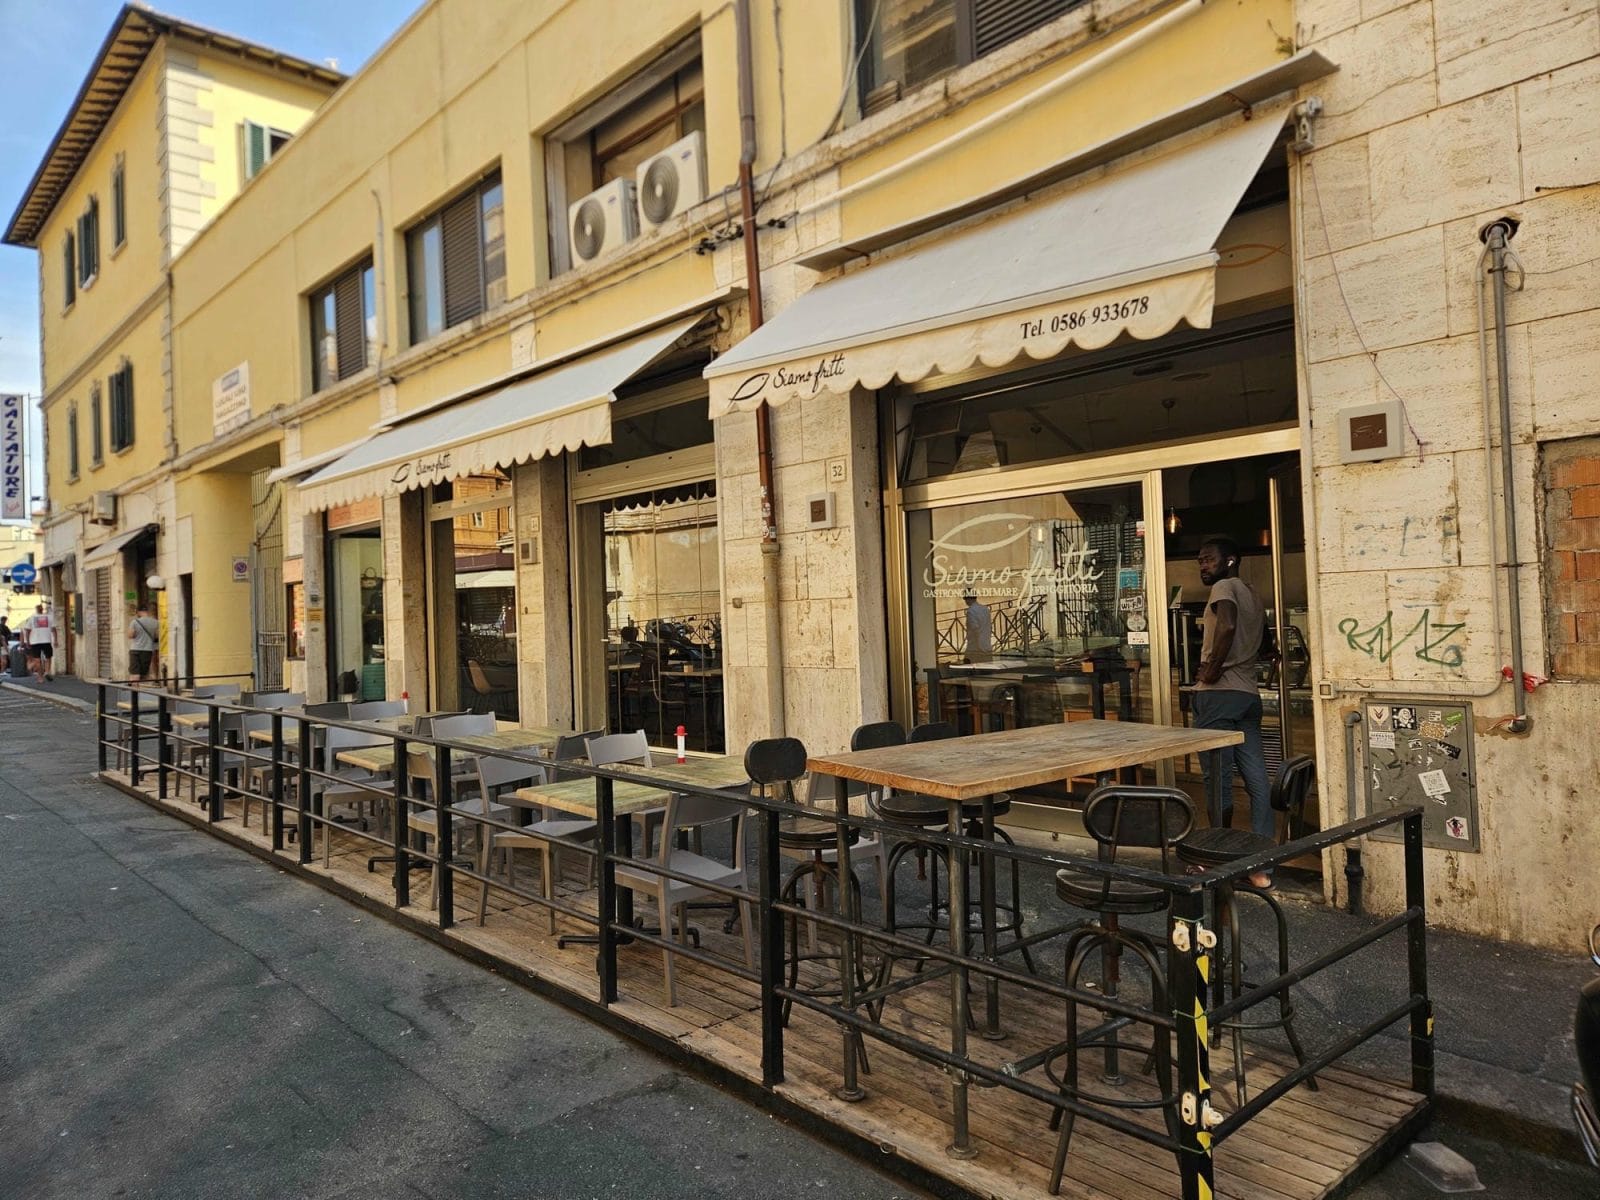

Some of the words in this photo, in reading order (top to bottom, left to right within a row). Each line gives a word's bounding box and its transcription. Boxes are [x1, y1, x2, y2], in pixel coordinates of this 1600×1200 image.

[1020, 319, 1045, 340] Tel.
[1051, 309, 1087, 333] 0586
[1092, 296, 1150, 325] 933678
[773, 367, 812, 389] Siamo
[811, 353, 846, 393] fritti
[4, 396, 20, 499] CALZATURE
[832, 464, 843, 477] 32
[922, 587, 980, 598] GASTRONOMIA
[983, 587, 991, 597] DI
[992, 587, 1018, 597] MARE
[923, 555, 1014, 587] Siamo
[1018, 541, 1104, 609] fritti
[1034, 583, 1099, 593] FRIGGITORIA
